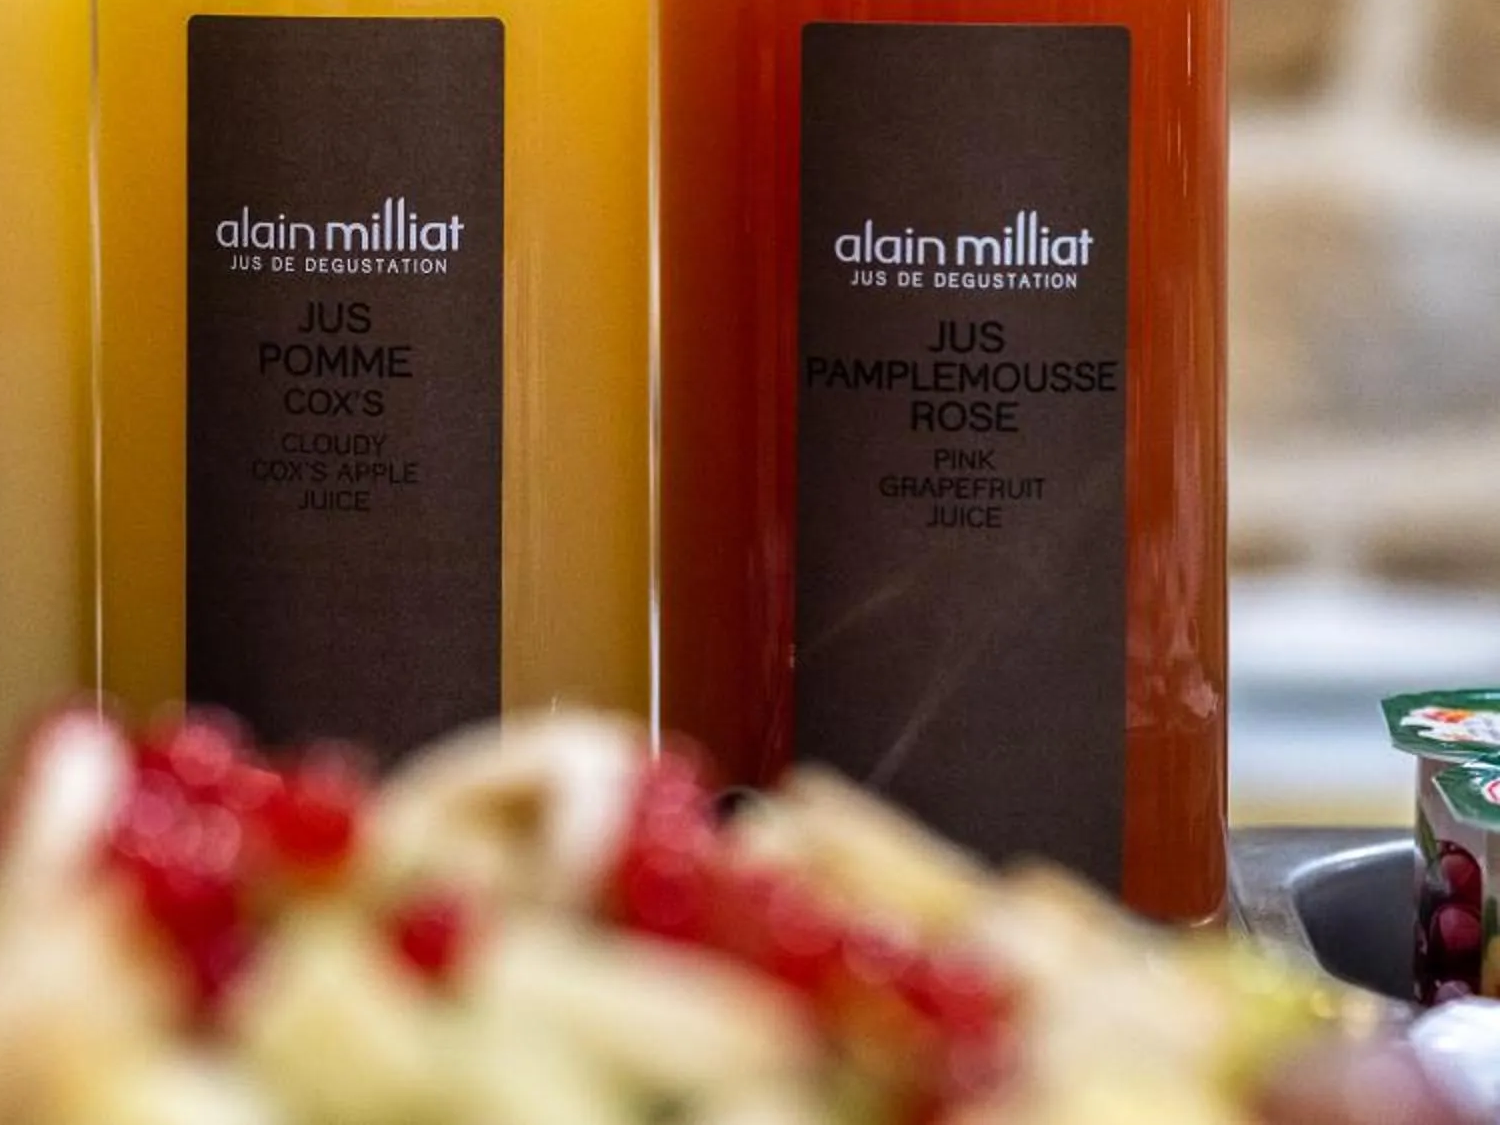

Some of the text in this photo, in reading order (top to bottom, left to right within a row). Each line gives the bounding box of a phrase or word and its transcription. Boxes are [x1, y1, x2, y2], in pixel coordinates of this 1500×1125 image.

[216, 197, 465, 251] alain milliat
[835, 211, 1093, 266] alain milliat
[230, 256, 447, 274] JUS DE DEGUSTATION
[852, 271, 1077, 288] JUS DE DEGUSTATION
[299, 301, 372, 334] JUS
[928, 321, 1004, 354] JUS
[258, 342, 413, 379] POMME
[806, 357, 1118, 393] PAMPLEMOUSSE
[284, 389, 384, 417] COX'S
[911, 401, 1020, 433] ROSE
[282, 433, 387, 456] CLOUDY
[252, 460, 419, 484] COX'S APPLE
[934, 449, 995, 471] PINK
[299, 490, 370, 512] JUICE
[880, 477, 1045, 500] GRAPEFRUIT
[927, 507, 1002, 529] JUICE
